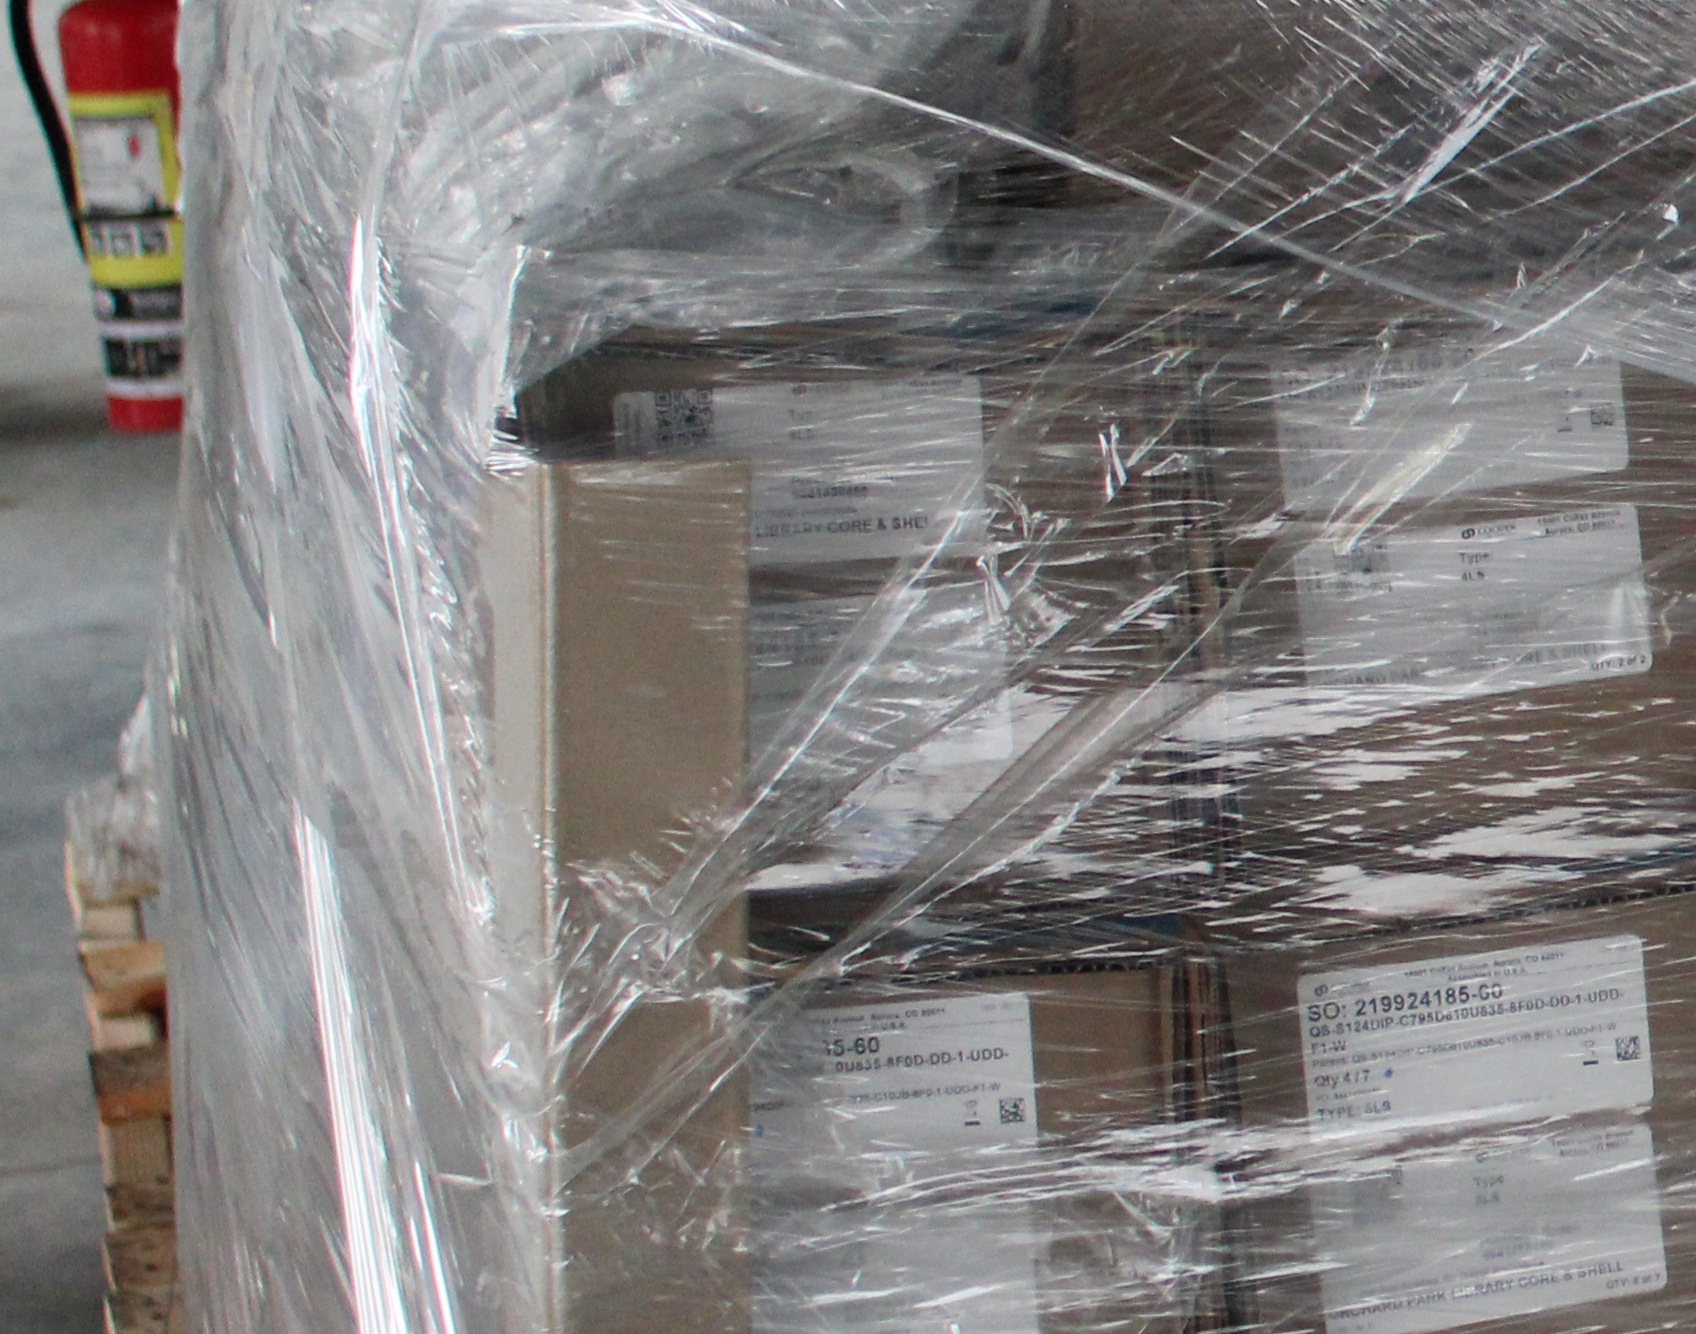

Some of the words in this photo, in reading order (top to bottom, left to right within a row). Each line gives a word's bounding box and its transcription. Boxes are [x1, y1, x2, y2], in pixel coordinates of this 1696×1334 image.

[876, 517, 887, 531] &
[1307, 1002, 1347, 1023] SO:
[1314, 1074, 1340, 1089] Qty
